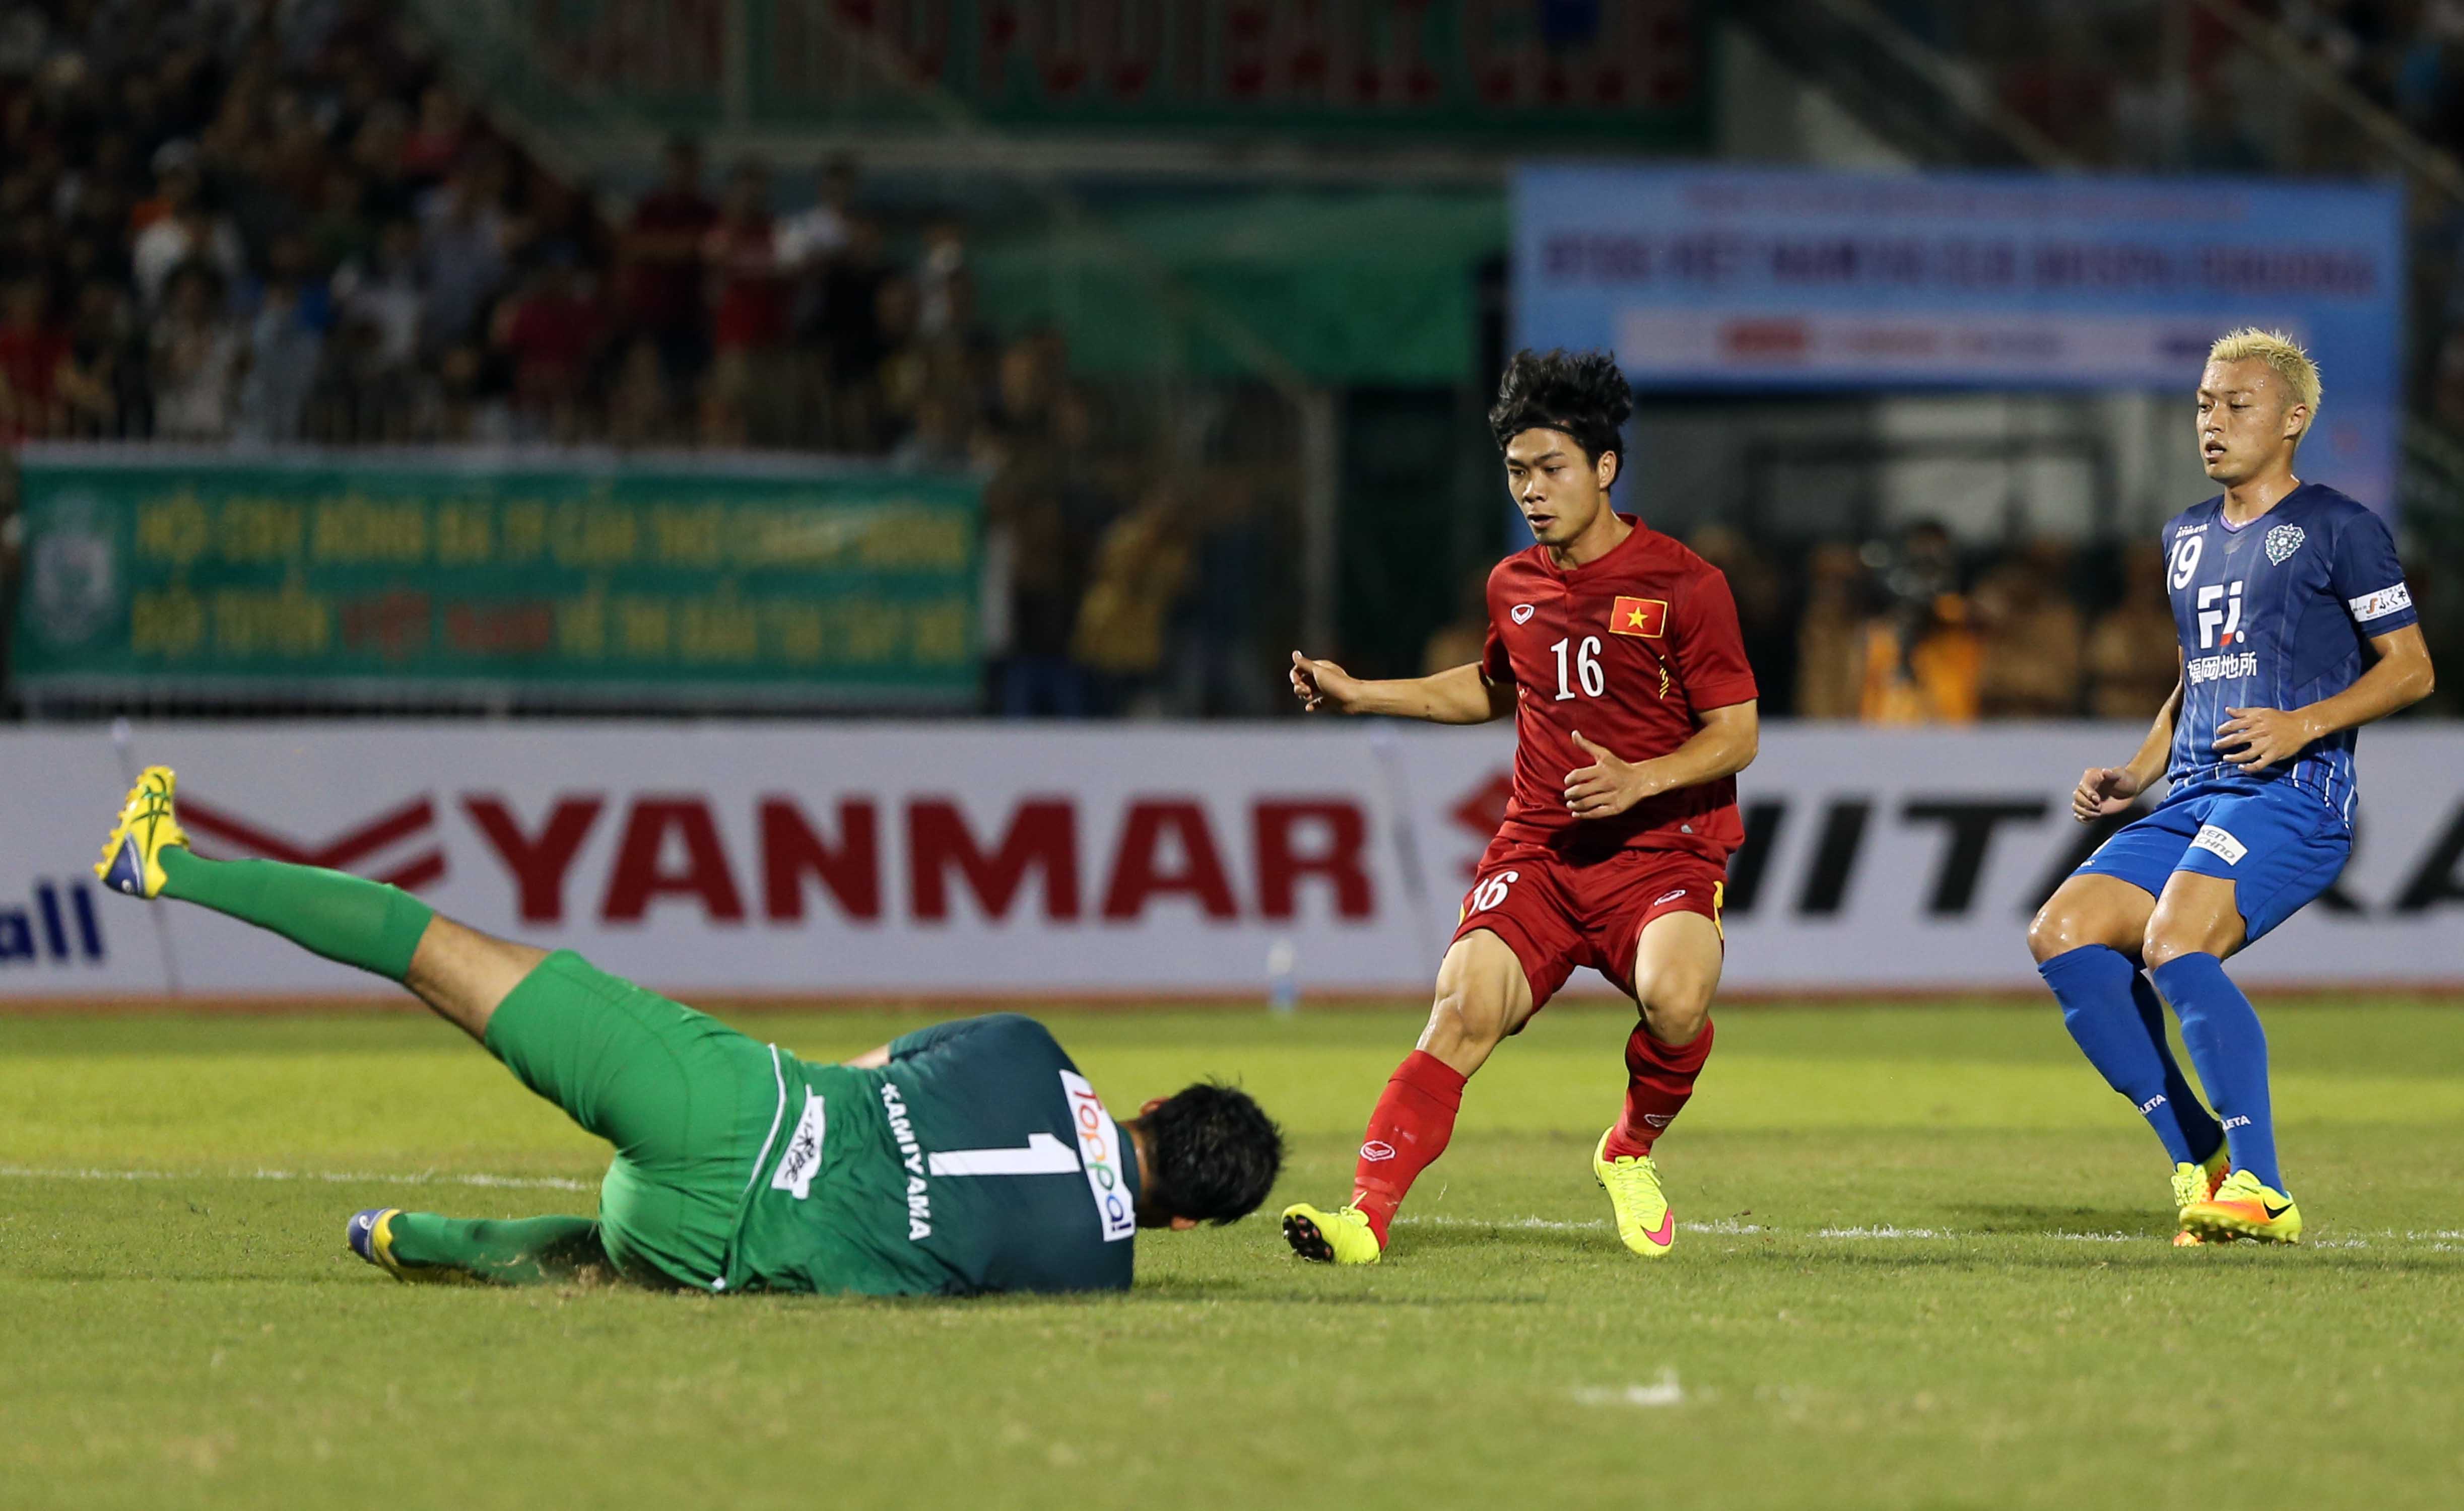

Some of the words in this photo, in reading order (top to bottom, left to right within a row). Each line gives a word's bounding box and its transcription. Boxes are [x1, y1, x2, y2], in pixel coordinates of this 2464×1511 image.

[2167, 535, 2203, 595] 19
[1551, 636, 1604, 701] 16
[2187, 651, 2257, 685] 福岡地所
[459, 793, 1378, 928] YANMAR
[1468, 870, 1519, 917] 16
[881, 1082, 932, 1241] KAMIYAMA
[928, 1133, 1082, 1176] 1
